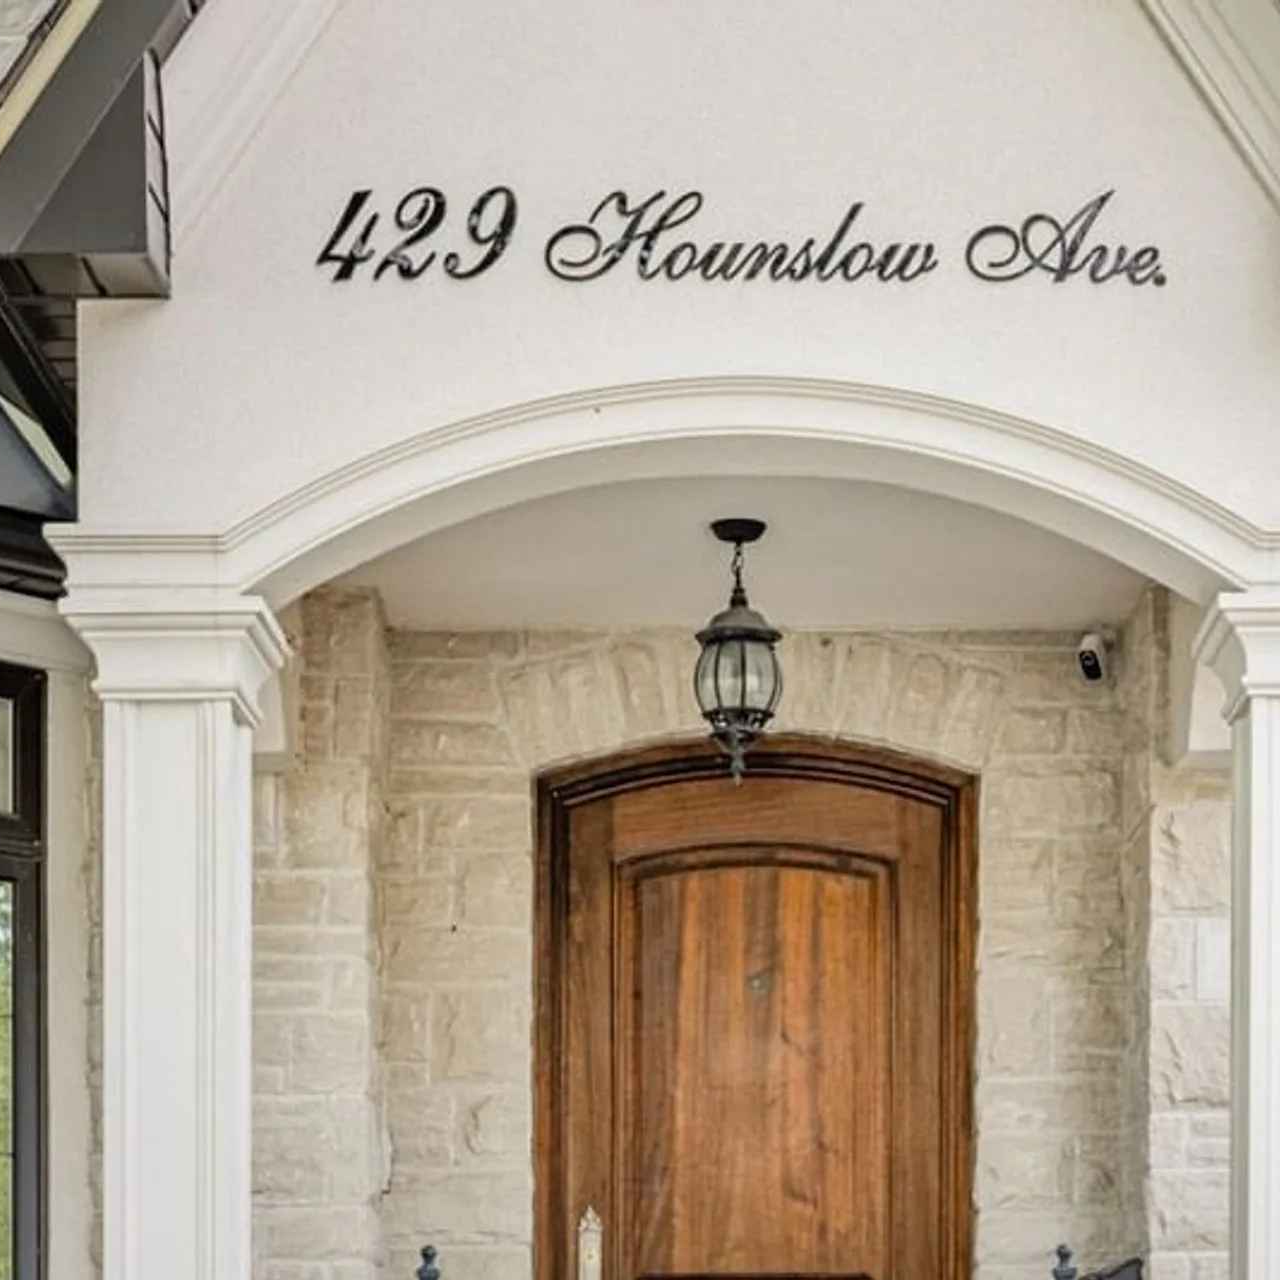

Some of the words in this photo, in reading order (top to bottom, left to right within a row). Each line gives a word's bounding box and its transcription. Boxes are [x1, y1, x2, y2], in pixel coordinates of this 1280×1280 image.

[315, 186, 518, 283] 429
[544, 190, 939, 283] Hounslow
[965, 189, 1168, 286] Ave.
